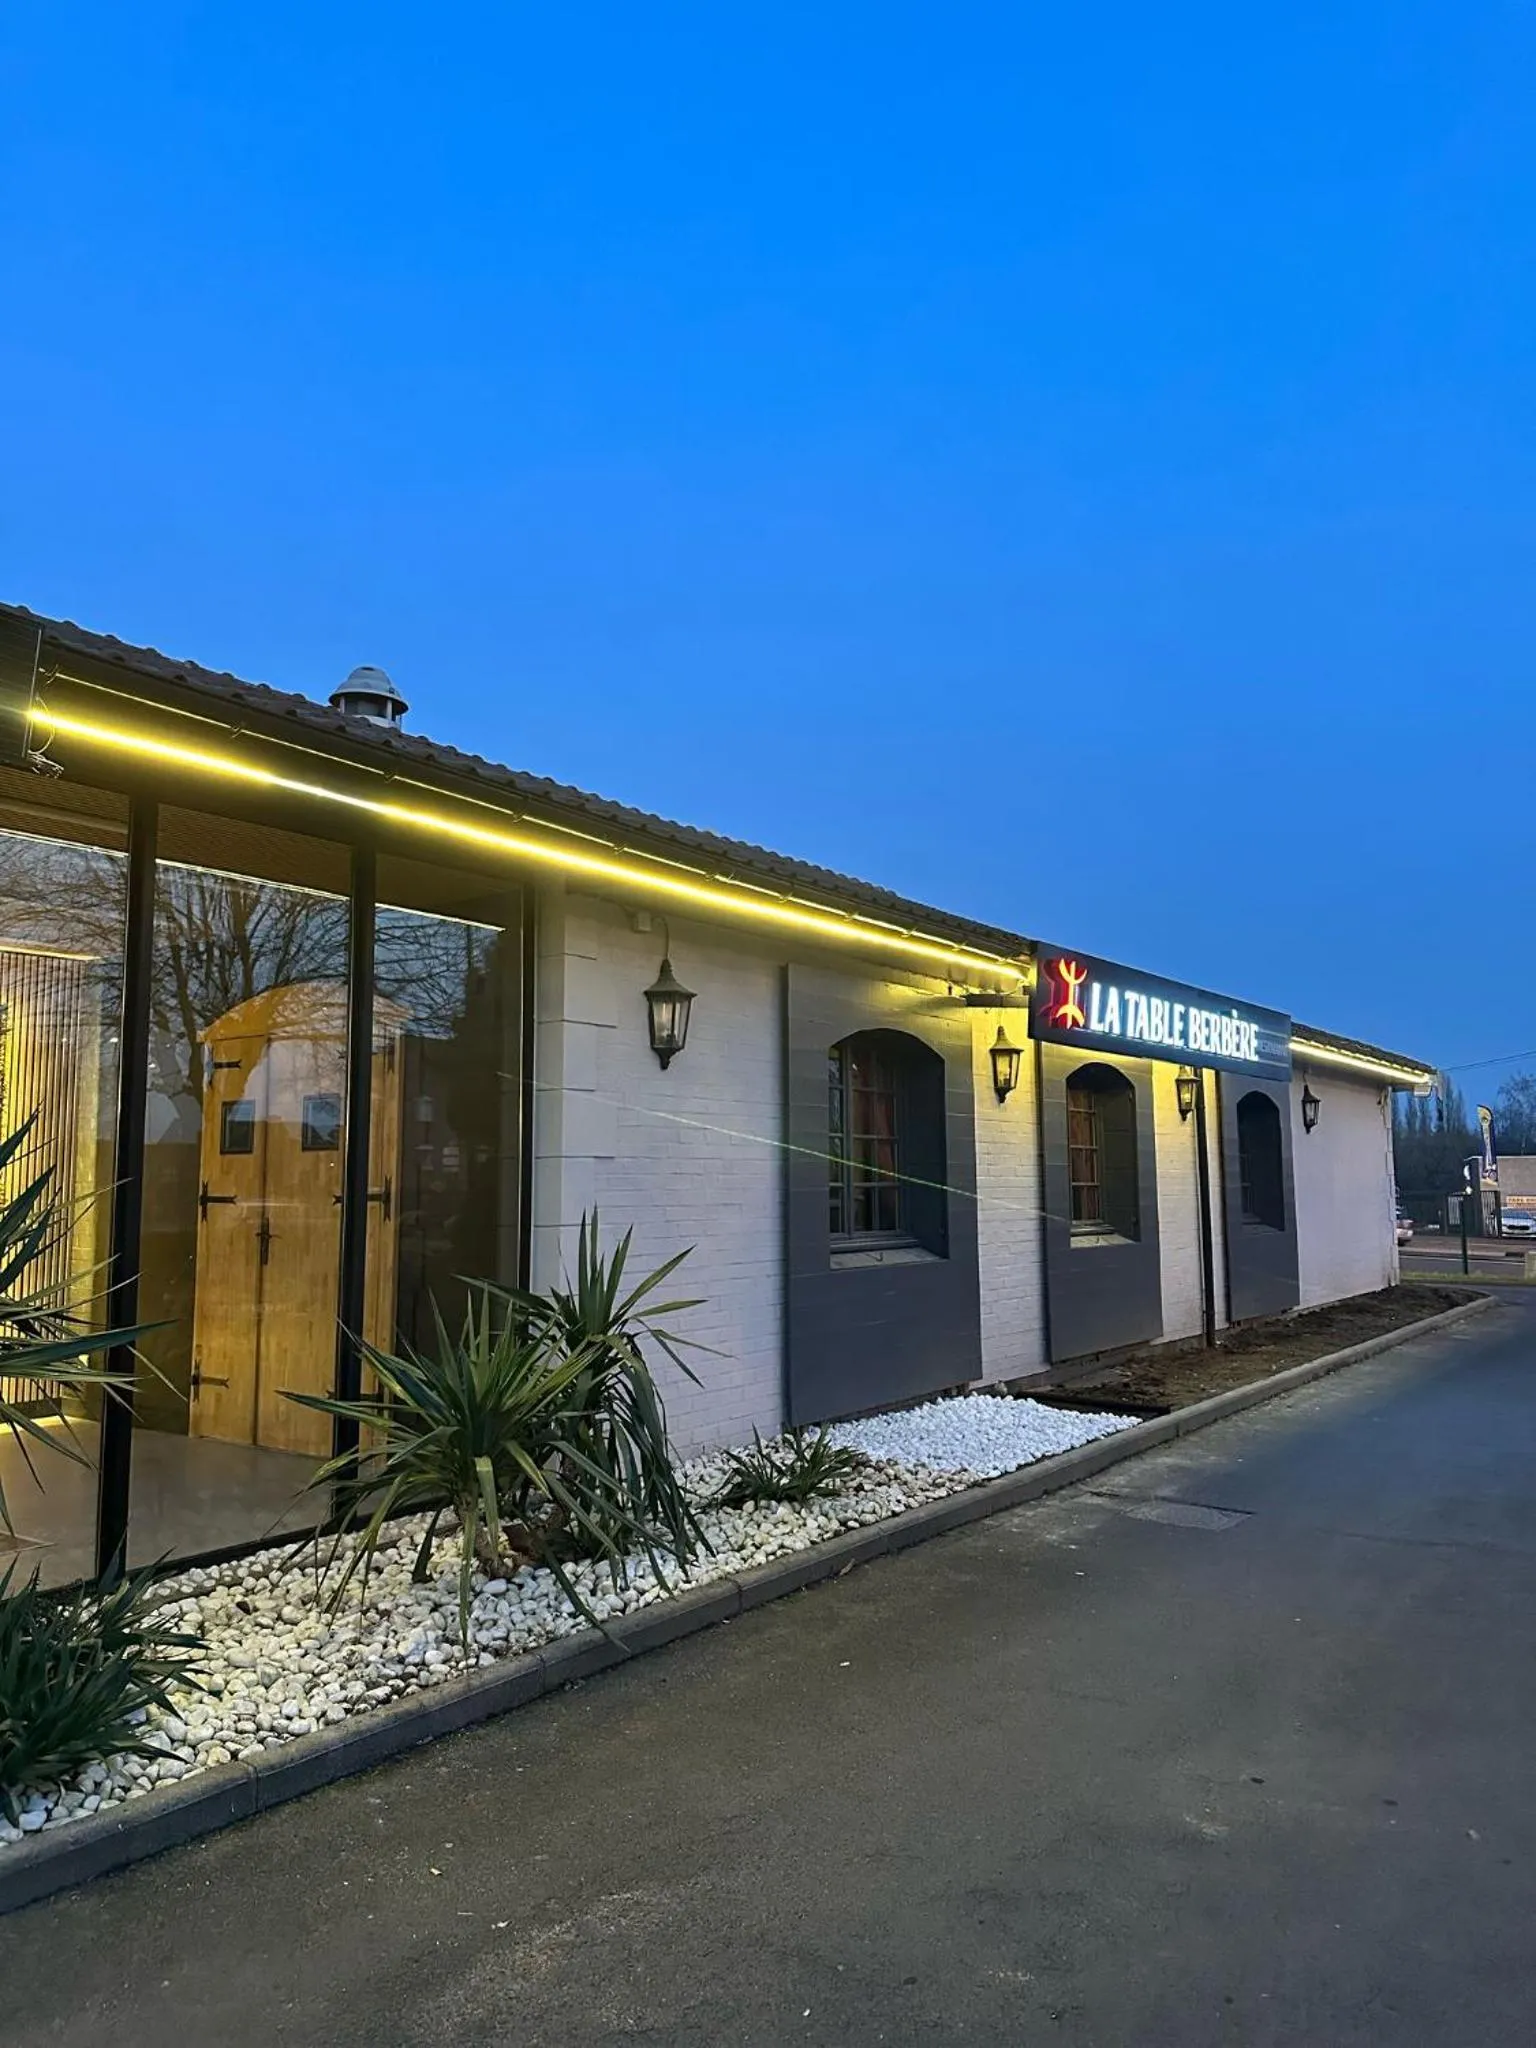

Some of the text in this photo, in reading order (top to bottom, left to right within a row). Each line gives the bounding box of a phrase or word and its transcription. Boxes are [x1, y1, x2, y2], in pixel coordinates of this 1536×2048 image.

[1090, 982, 1259, 1061] LA TABLE BERBÈRE
